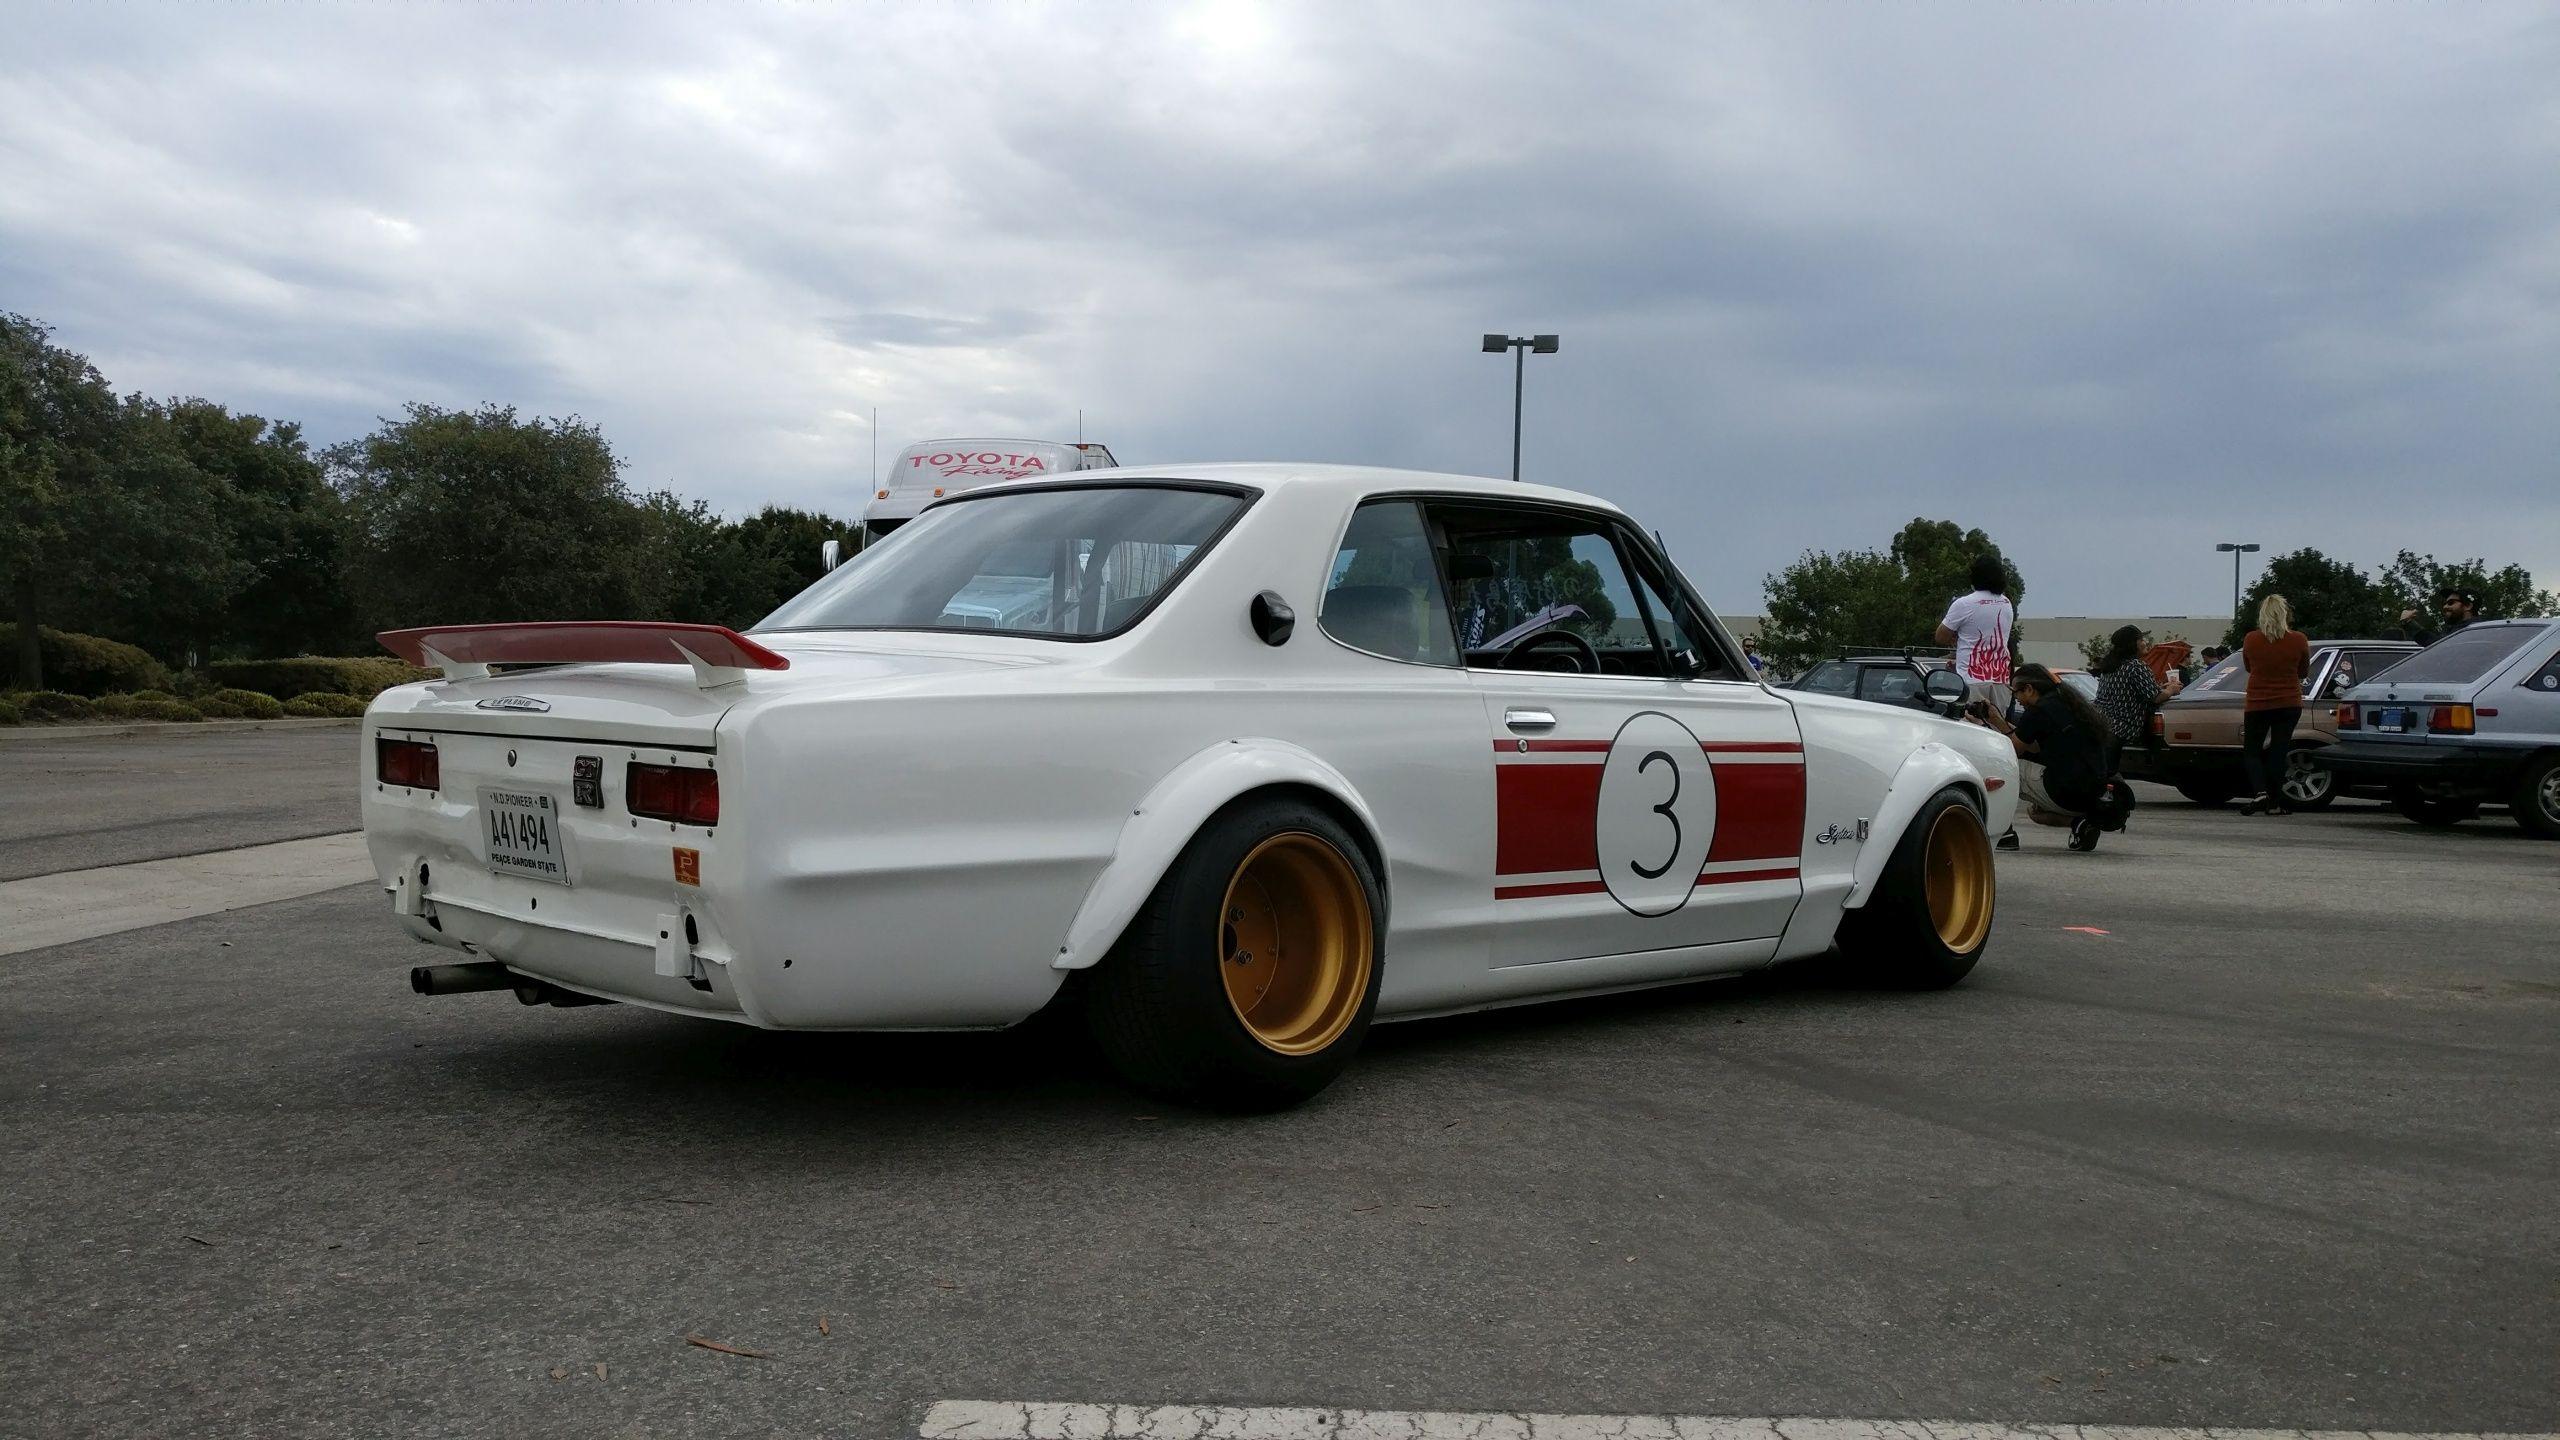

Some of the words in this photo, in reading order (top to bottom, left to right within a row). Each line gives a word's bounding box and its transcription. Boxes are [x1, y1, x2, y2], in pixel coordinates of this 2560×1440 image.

[909, 452, 1045, 471] TOYOTA
[1630, 750, 1682, 879] 3
[490, 809, 550, 855] A41494
[491, 852, 511, 866] PEACE
[511, 856, 537, 869] GARDEN
[537, 861, 558, 874] STATE
